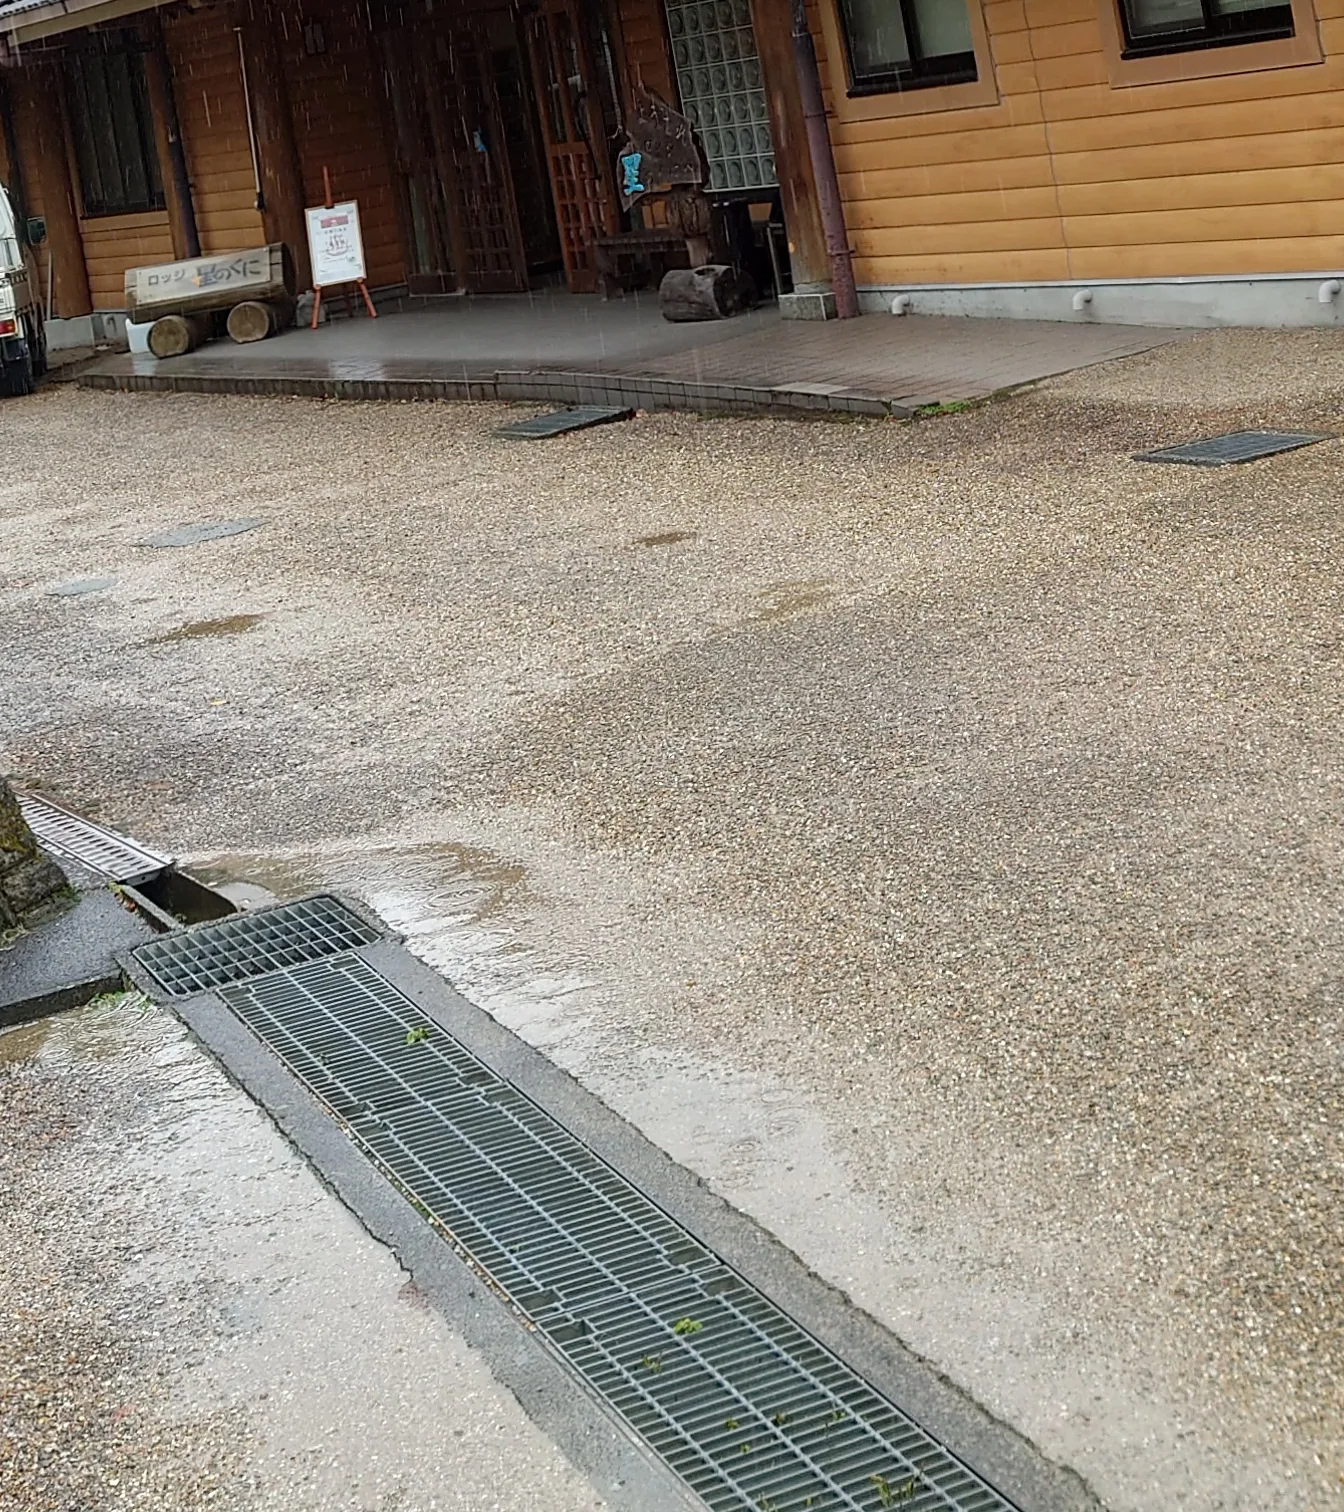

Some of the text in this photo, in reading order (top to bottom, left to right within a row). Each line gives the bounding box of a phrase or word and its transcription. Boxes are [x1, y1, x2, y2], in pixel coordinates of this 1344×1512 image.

[147, 258, 262, 288] ロッジ 星のくに
